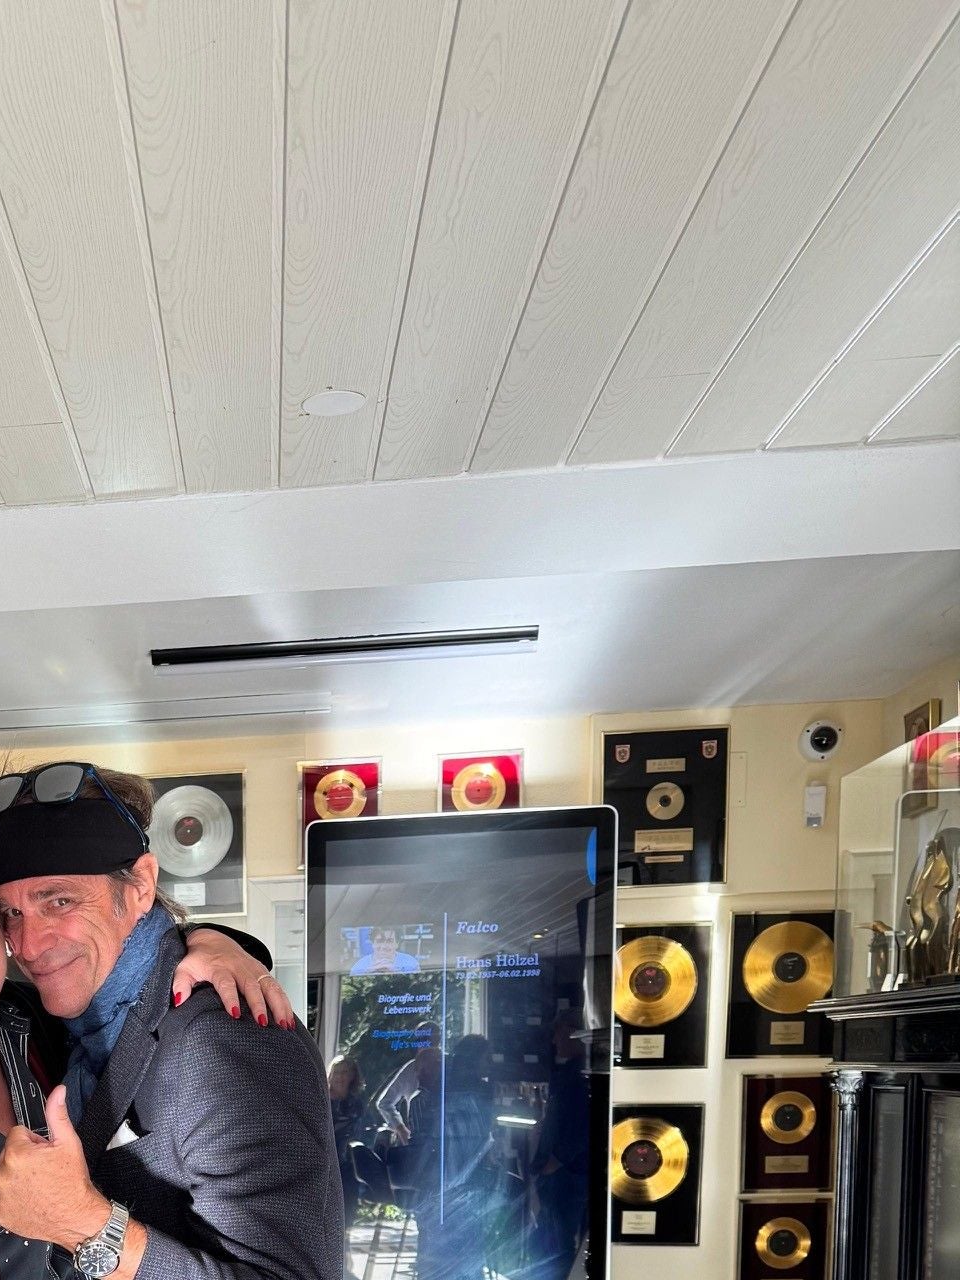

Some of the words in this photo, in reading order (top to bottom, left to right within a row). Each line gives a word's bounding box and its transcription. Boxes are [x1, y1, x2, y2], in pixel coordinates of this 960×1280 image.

[456, 920, 499, 935] Falco
[456, 956, 492, 969] Hans
[495, 952, 540, 967] Hölzel
[378, 993, 415, 1005] Biografie
[415, 993, 432, 1002] und
[383, 1005, 432, 1015] Lebenswerk
